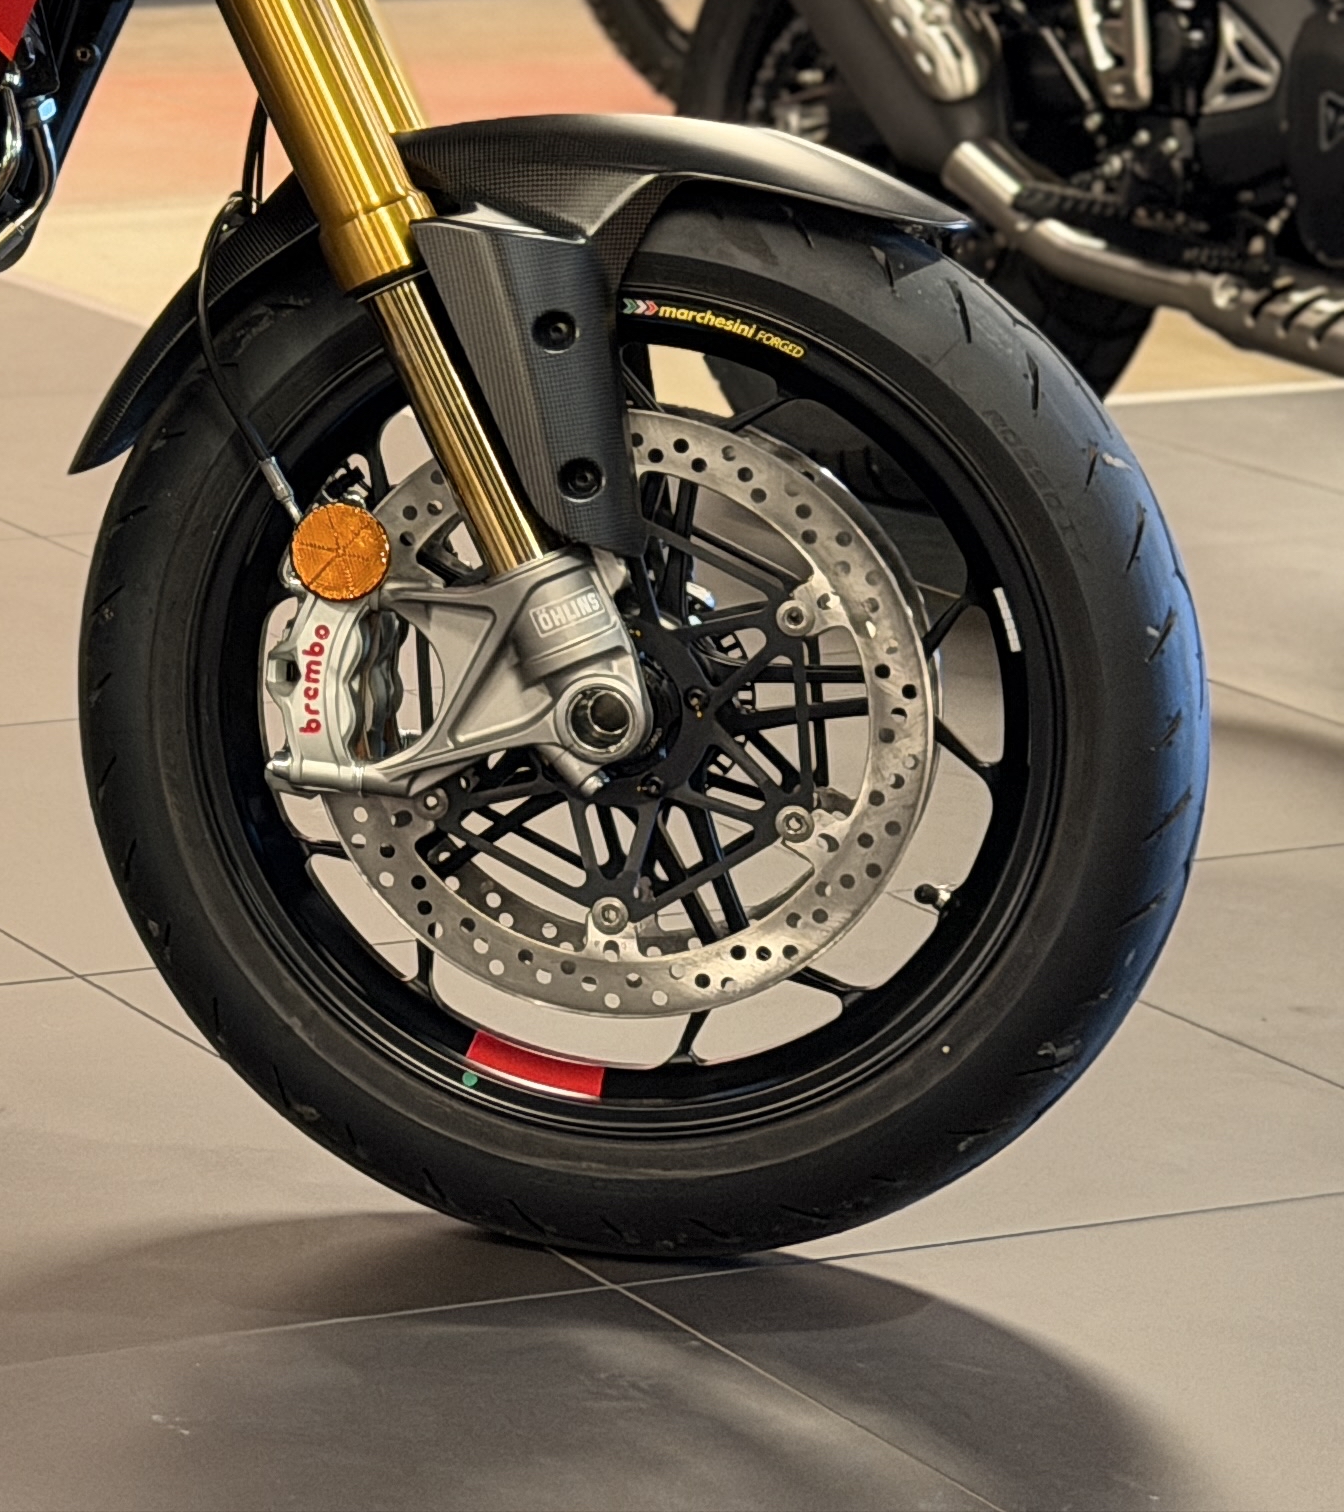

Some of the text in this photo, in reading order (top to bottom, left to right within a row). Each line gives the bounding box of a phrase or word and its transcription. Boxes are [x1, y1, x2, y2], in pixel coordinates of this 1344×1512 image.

[657, 303, 805, 359] marchesini FORGED
[535, 591, 601, 631] ÖHLINS
[298, 624, 331, 734] brembo
